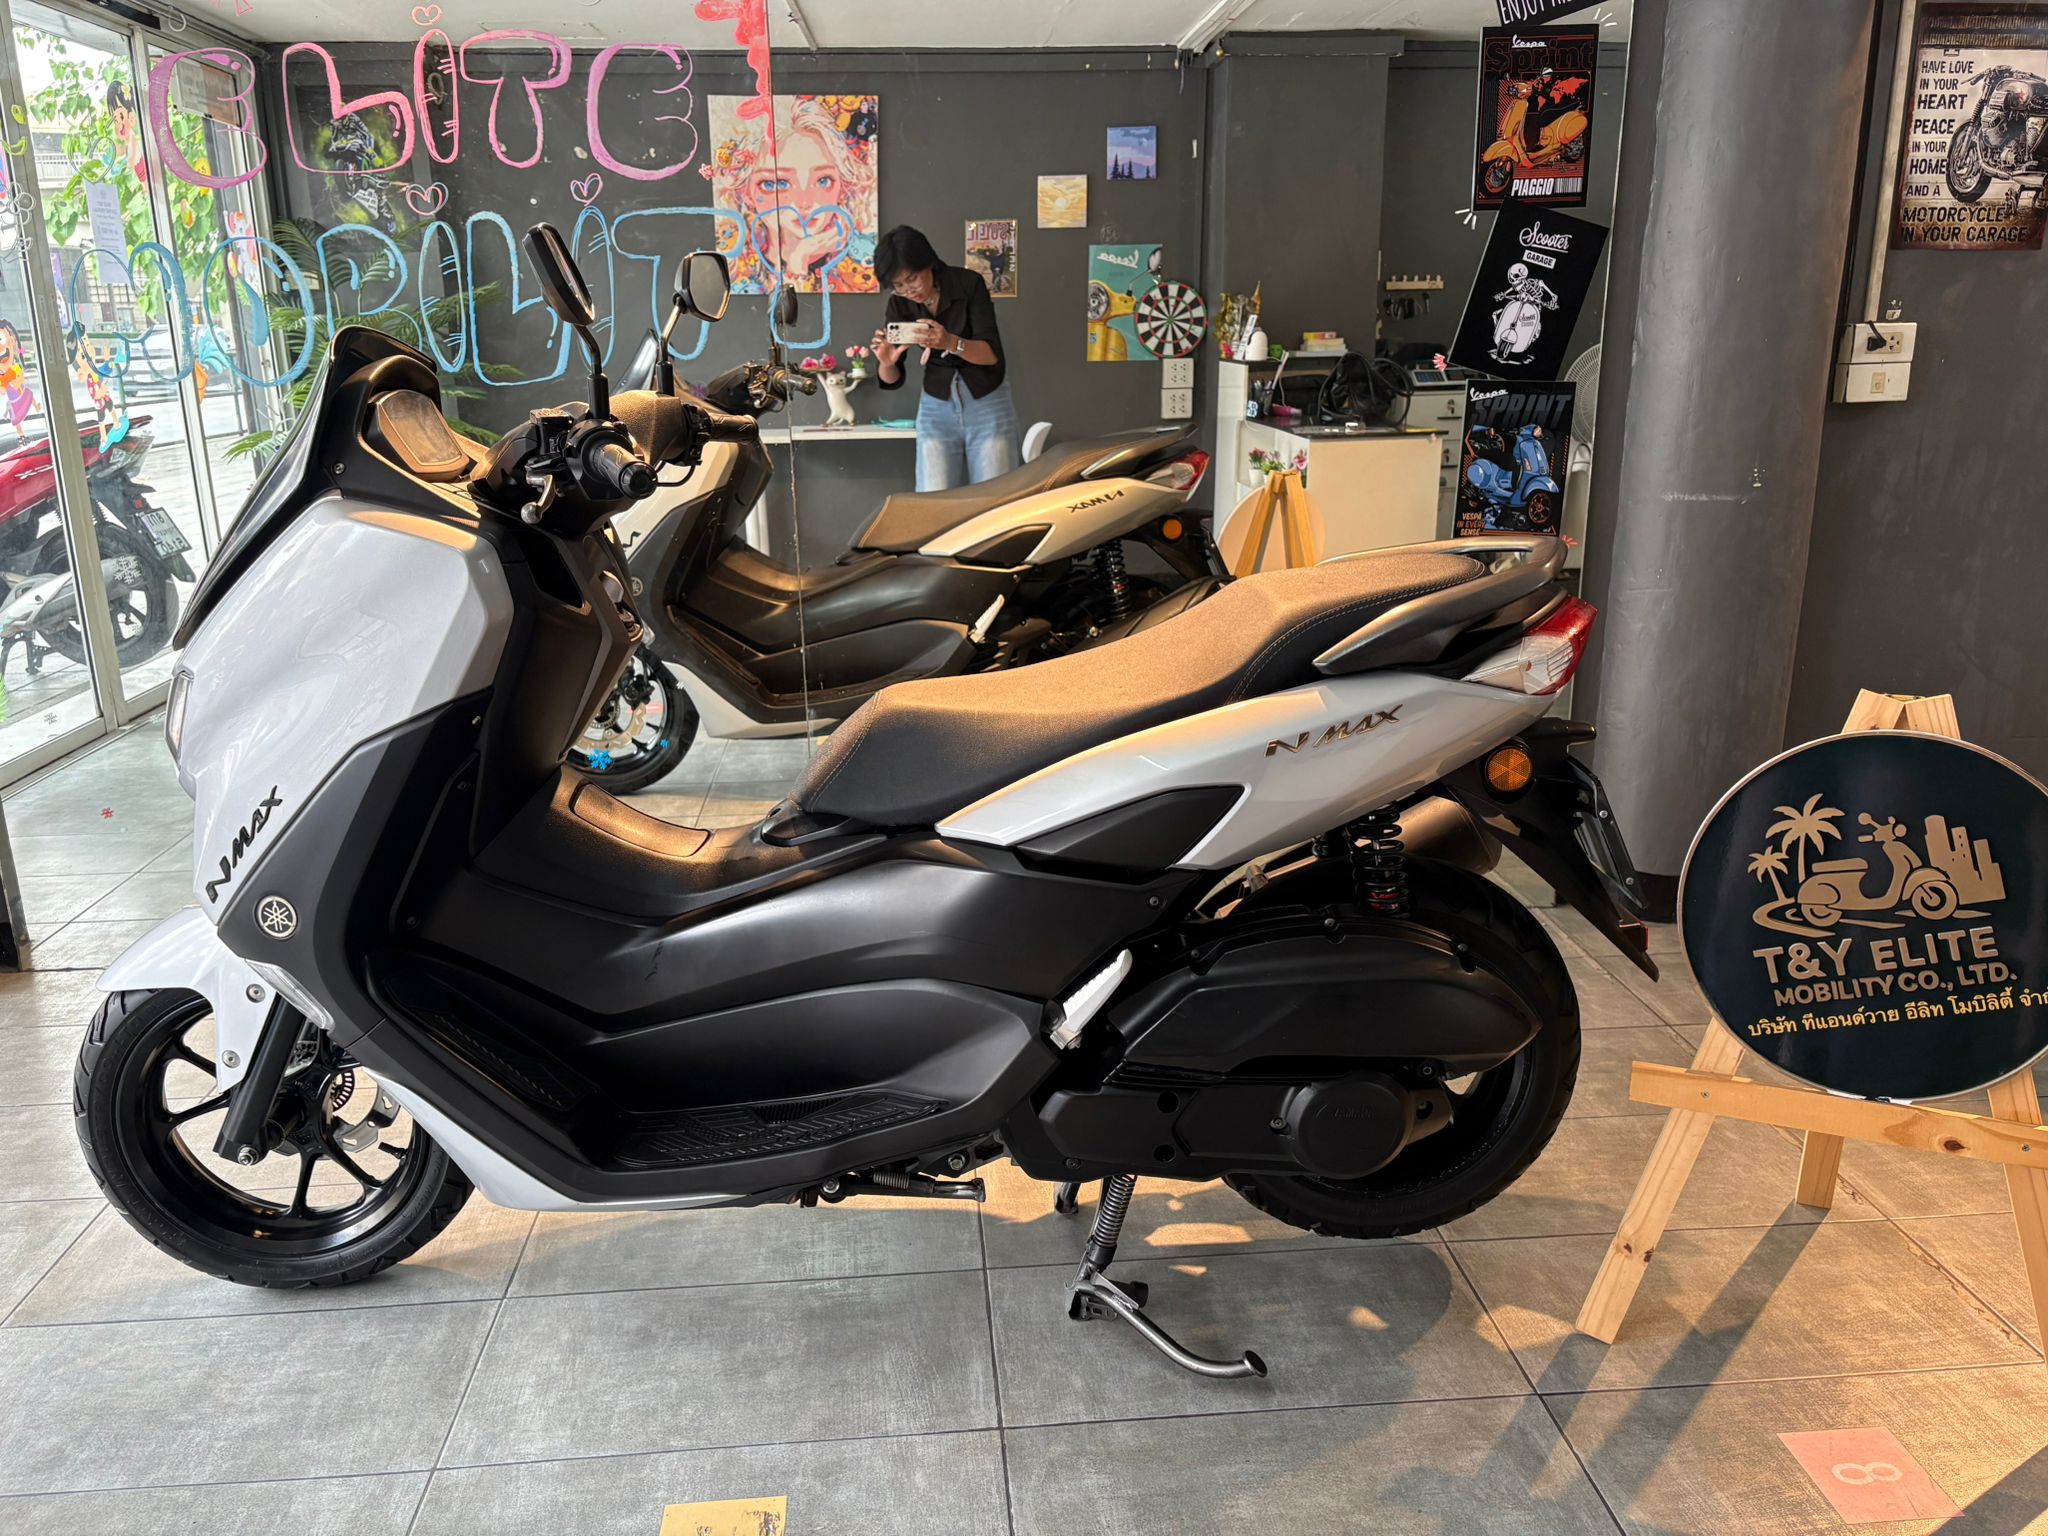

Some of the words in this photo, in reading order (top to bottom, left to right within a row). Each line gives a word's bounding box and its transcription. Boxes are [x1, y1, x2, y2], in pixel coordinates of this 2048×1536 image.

[1511, 34, 1547, 48] Vespa
[1486, 39, 1594, 75] Sprint
[1921, 61, 1946, 74] HAVE
[1949, 61, 1974, 74] LOVE
[1920, 79, 1930, 90] IN
[1934, 79, 1958, 90] YOUR
[1917, 94, 1968, 109] HEART
[1913, 119, 1955, 134] PEACE
[1912, 141, 1921, 153] IN
[1924, 141, 1947, 153] YOUR
[1909, 159, 1947, 175] HOME
[1511, 178, 1555, 197] PIAGGIO
[1906, 185, 1929, 197] AND
[1932, 185, 1941, 197] A
[1902, 206, 2005, 222] MOTORCYCLE
[1519, 221, 1573, 251] Scooter
[1901, 227, 1915, 242] IN
[1921, 227, 1961, 242] YOUR
[1966, 227, 2028, 242] GARAGE
[1526, 252, 1553, 266] GARAGE
[1470, 387, 1508, 402] Vespa
[1470, 394, 1572, 428] SPRINT
[1462, 512, 1482, 520] VESPA
[1264, 704, 1403, 757] NMAX
[205, 785, 283, 904] NMAX
[1753, 938, 1852, 984] T&Y
[1870, 926, 1999, 971] ELITE
[1774, 975, 1894, 1007] MOBILITY
[1957, 962, 2018, 986] LTD.
[1748, 1015, 1797, 1037] บริษัท
[1802, 1005, 1900, 1032] ทีแอนด์วาย
[1905, 1000, 1945, 1020] อีลิท
[1947, 986, 2014, 1015] โมบิลิตี้
